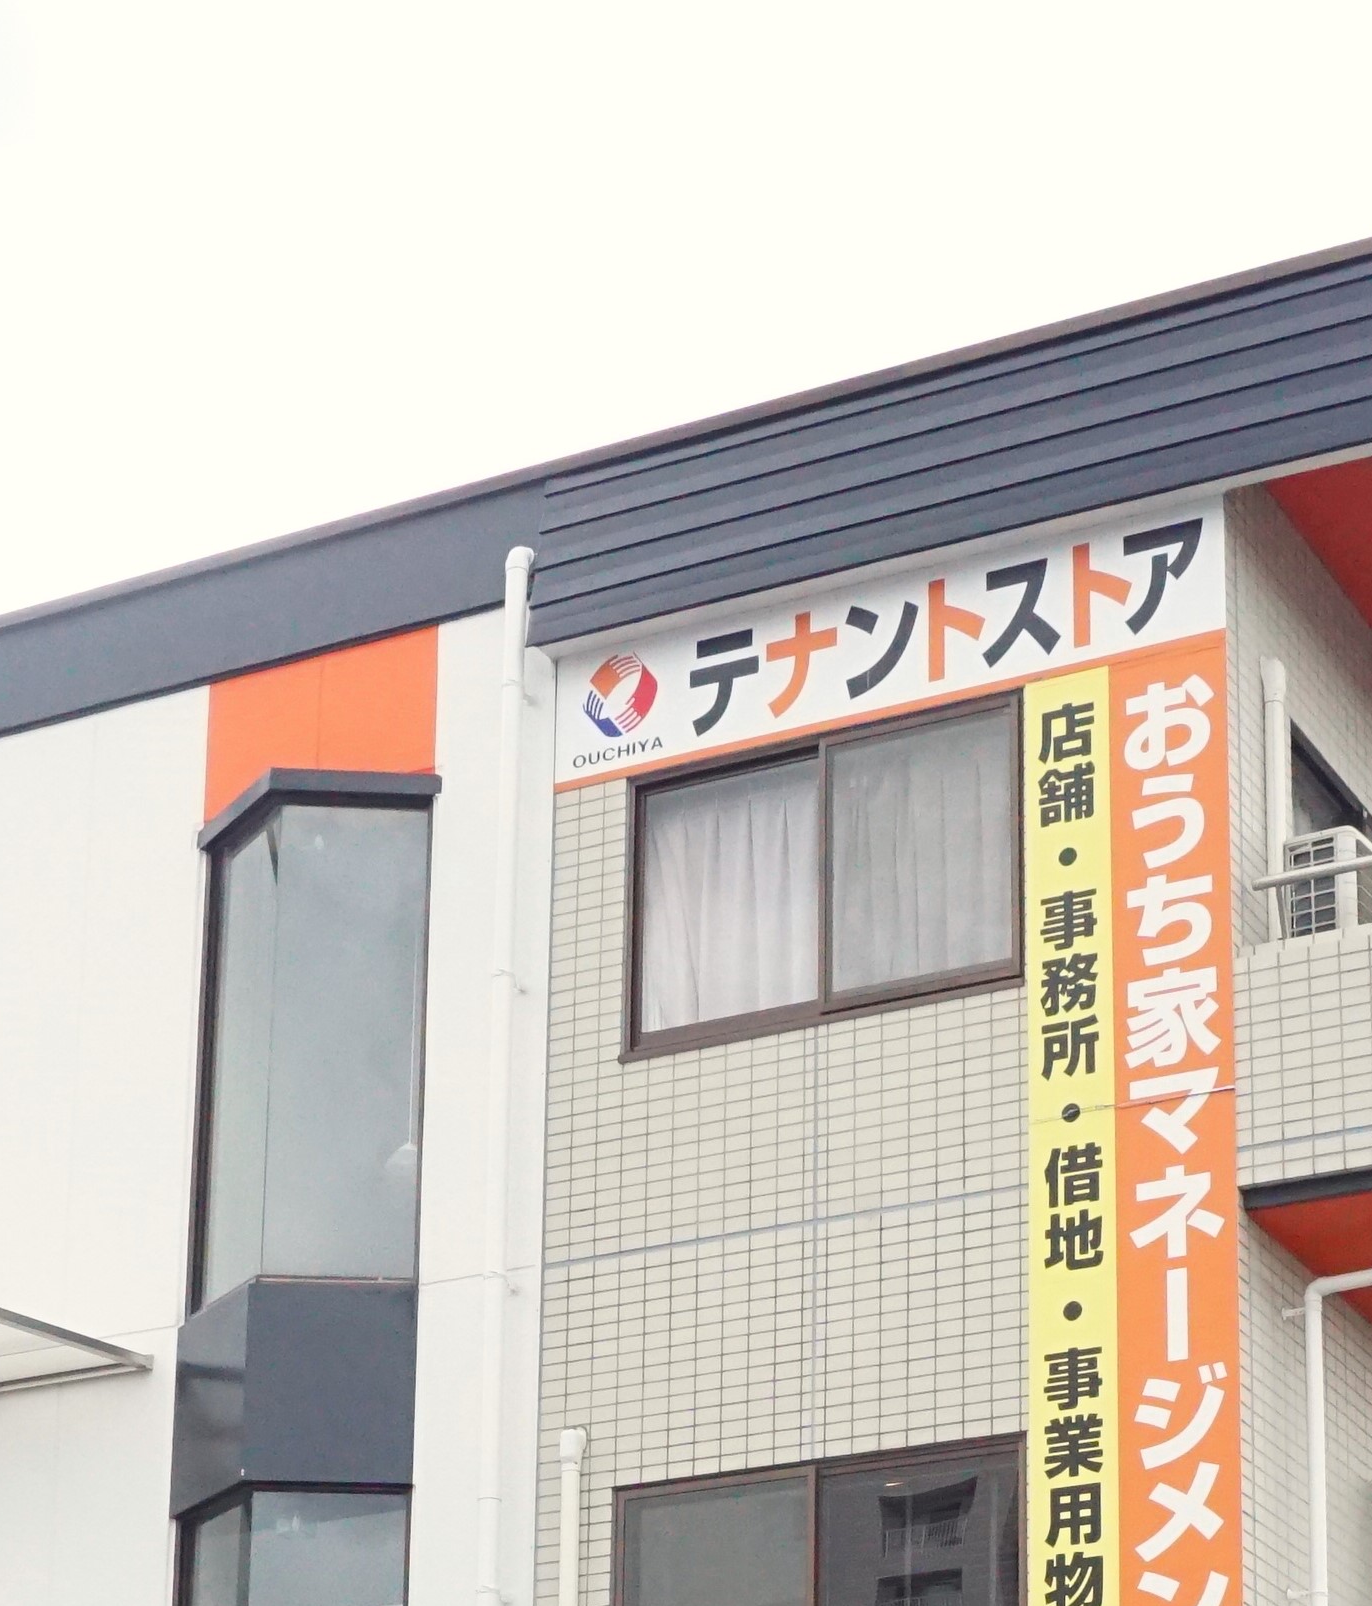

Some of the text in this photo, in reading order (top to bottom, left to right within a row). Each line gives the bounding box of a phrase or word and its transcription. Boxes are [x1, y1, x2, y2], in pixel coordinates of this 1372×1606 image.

[689, 517, 1204, 737] テナントストア
[572, 735, 664, 769] OUCHIYA
